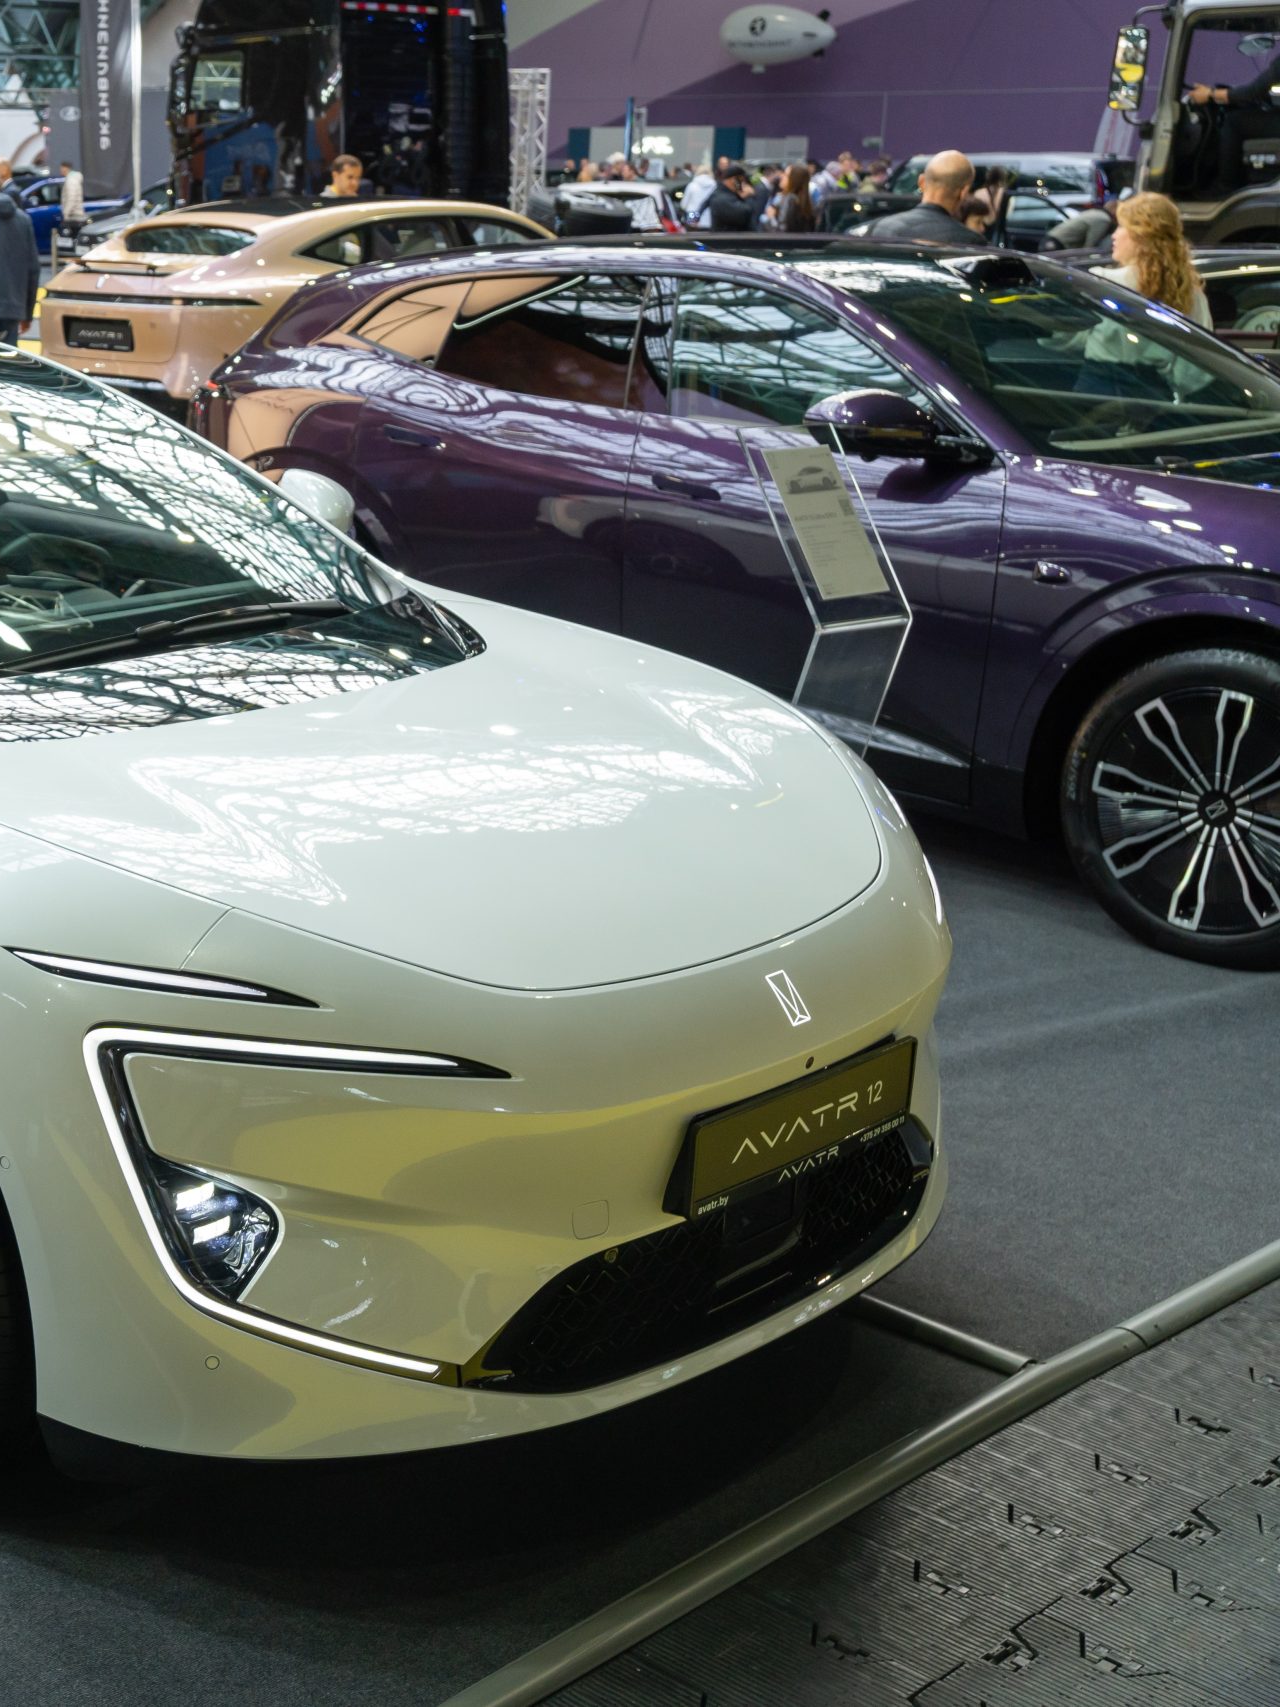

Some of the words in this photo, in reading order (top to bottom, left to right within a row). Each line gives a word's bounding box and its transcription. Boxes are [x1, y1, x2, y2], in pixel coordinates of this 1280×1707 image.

[731, 1091, 858, 1164] AVATR
[867, 1080, 883, 1105] 12
[778, 1145, 839, 1183] AVATR
[698, 1195, 729, 1215] avatr.by
